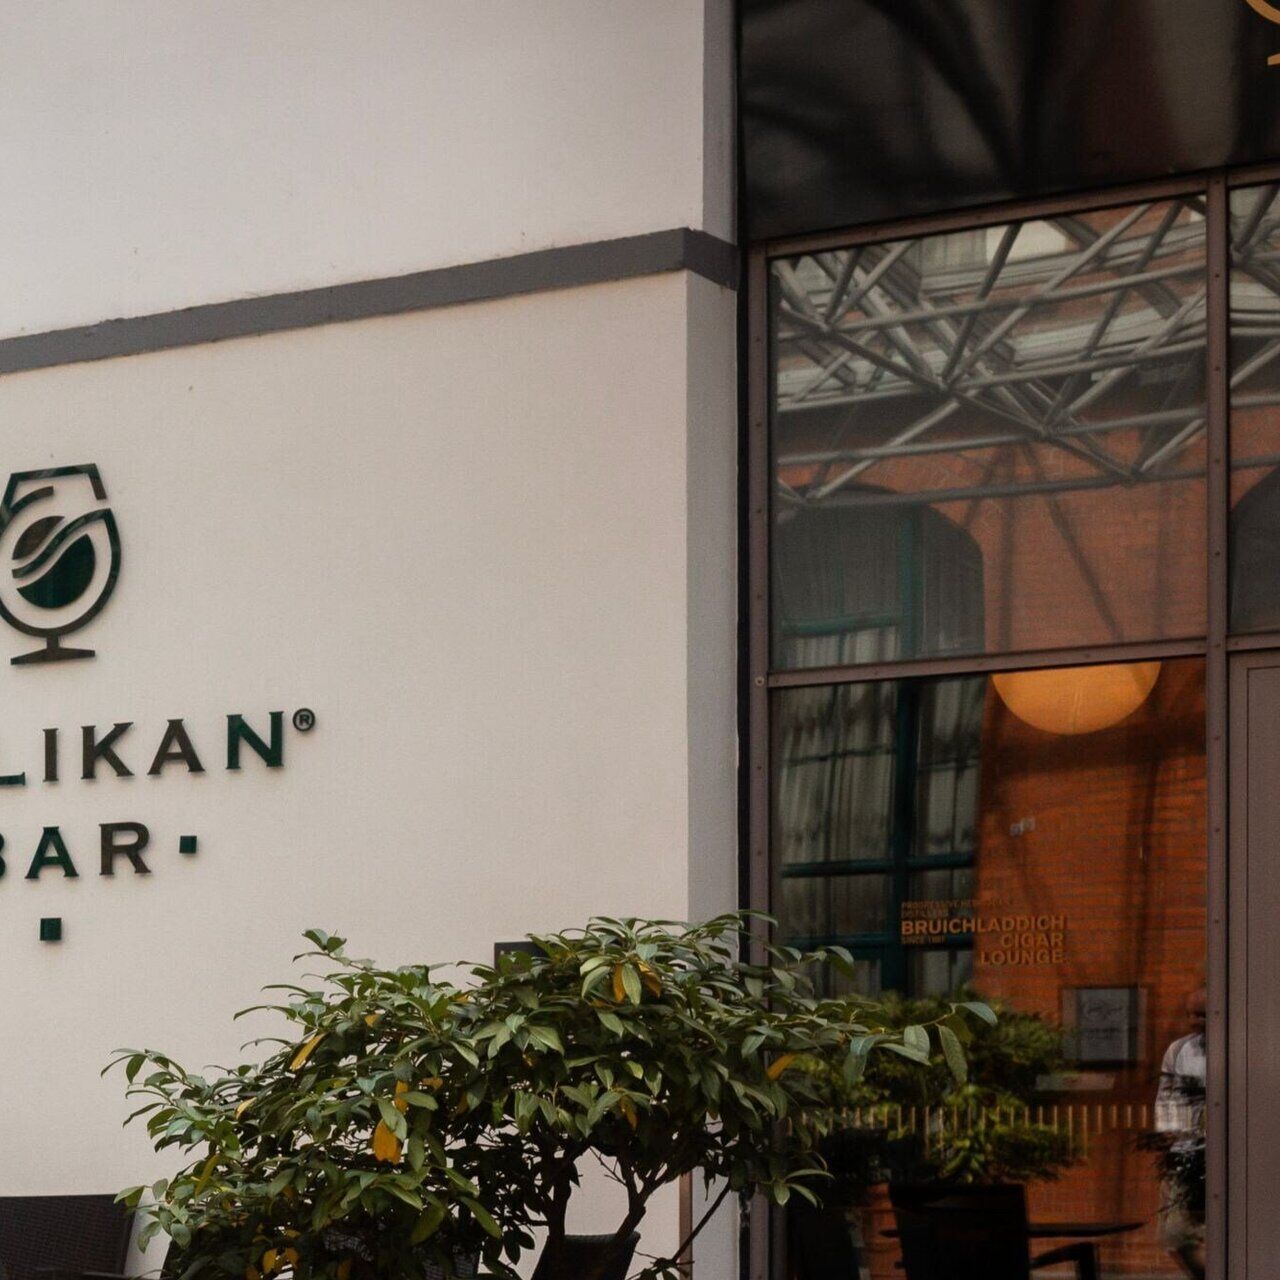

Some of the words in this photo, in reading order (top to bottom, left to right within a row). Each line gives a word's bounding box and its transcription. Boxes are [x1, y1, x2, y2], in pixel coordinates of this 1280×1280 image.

[901, 915, 1065, 936] BRUICHLADDICH
[1002, 933, 1064, 948] CIGAR
[981, 950, 1064, 966] LOUNGE
